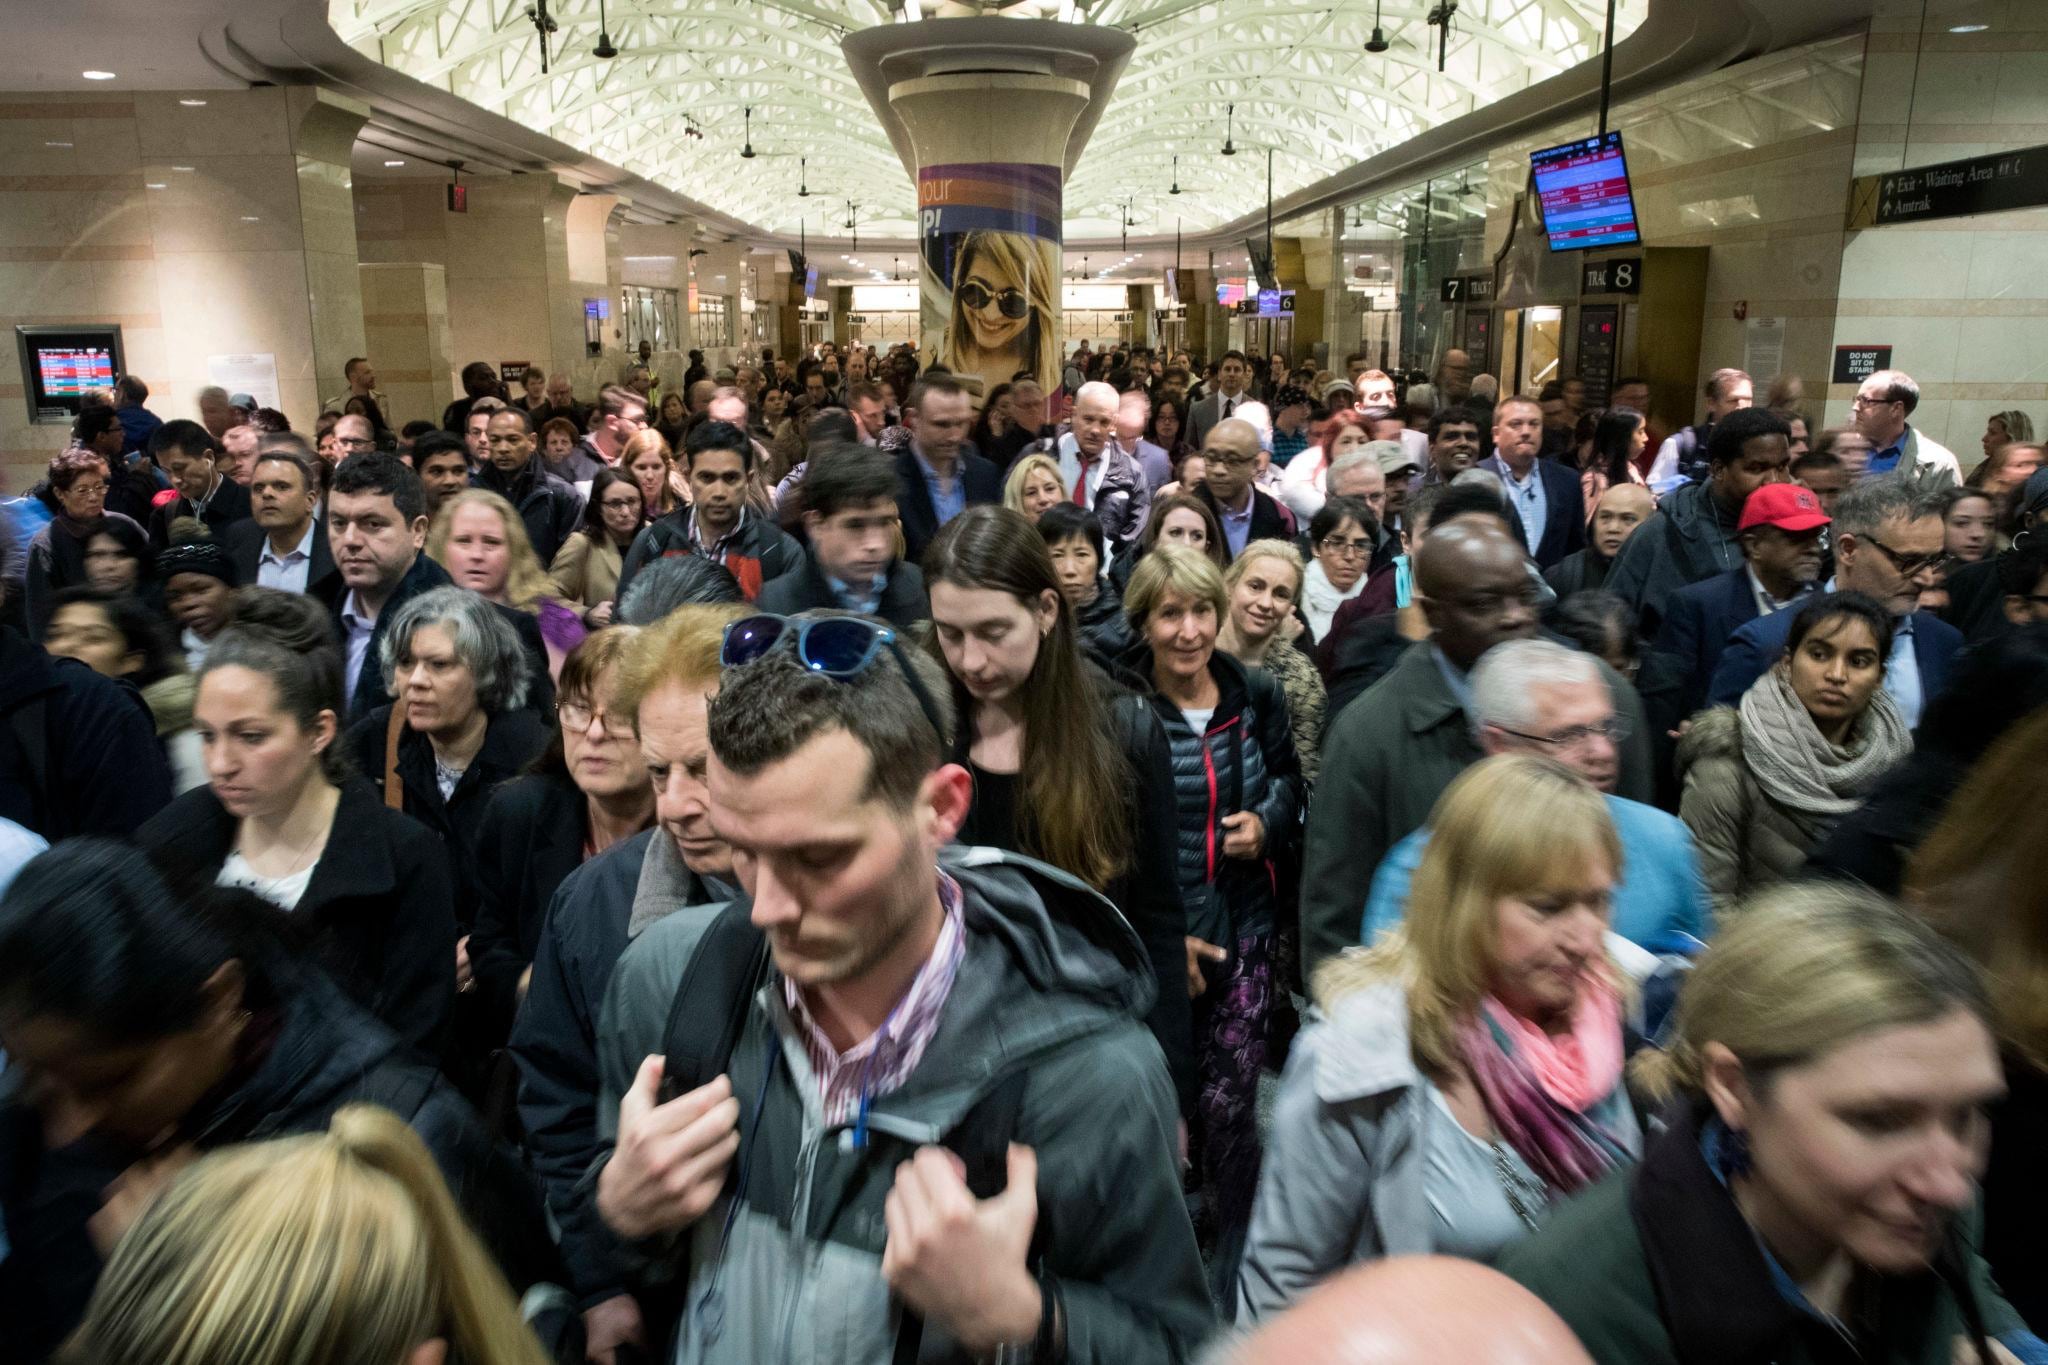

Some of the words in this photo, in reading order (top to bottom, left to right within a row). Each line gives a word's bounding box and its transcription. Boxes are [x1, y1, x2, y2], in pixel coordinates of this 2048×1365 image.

[1897, 175, 1915, 193] Exit
[1926, 170, 1964, 187] Waiting
[1967, 165, 1993, 182] Area
[1894, 195, 1931, 215] Amtrak
[1588, 270, 1607, 287] TRAC
[1615, 264, 1633, 287] 8
[1448, 281, 1459, 299] 7
[1471, 281, 1487, 295] TRACK
[1240, 302, 1246, 312] 5
[1283, 297, 1291, 309] 6
[1848, 366, 1875, 374] STAIRS
